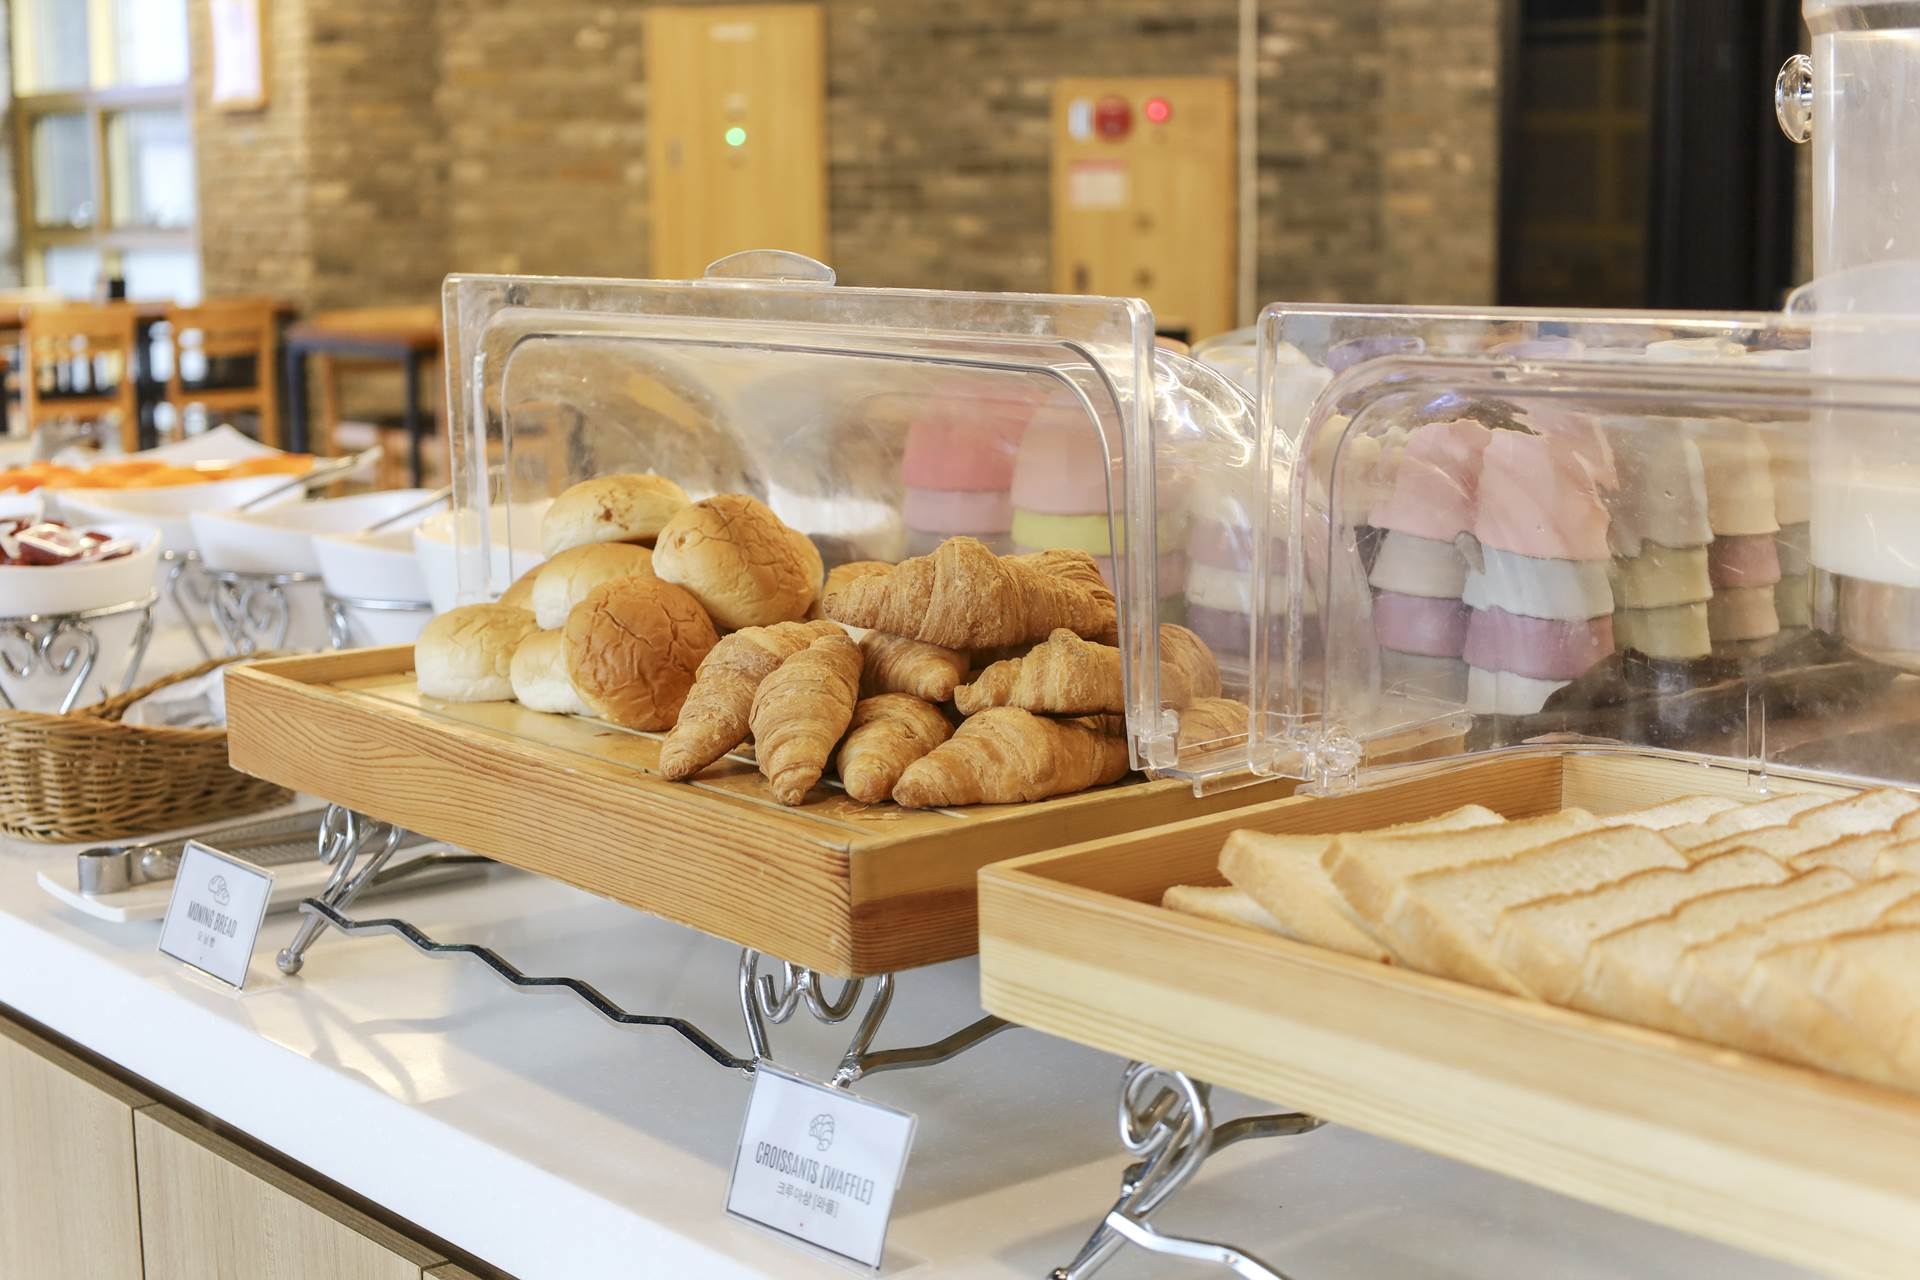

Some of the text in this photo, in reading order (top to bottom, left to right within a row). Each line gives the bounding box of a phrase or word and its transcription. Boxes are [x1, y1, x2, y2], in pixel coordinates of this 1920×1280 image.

[213, 912, 238, 938] BREAD
[755, 1141, 875, 1206] CROISSANTS [WAFFLE]
